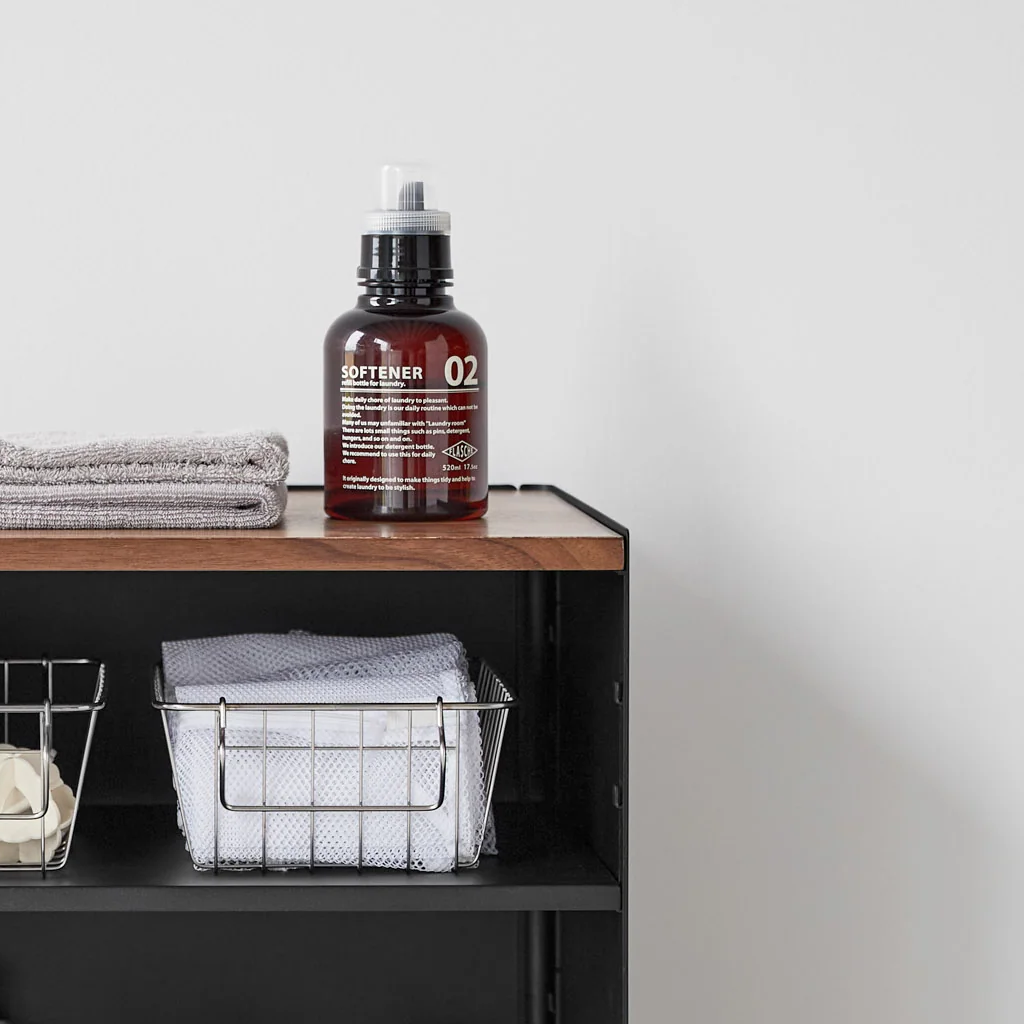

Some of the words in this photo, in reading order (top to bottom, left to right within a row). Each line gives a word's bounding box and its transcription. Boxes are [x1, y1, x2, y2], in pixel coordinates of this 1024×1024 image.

[341, 366, 422, 380] SOFTENER
[444, 355, 478, 386] 02
[380, 380, 406, 388] laundry.
[357, 484, 378, 492] laundry
